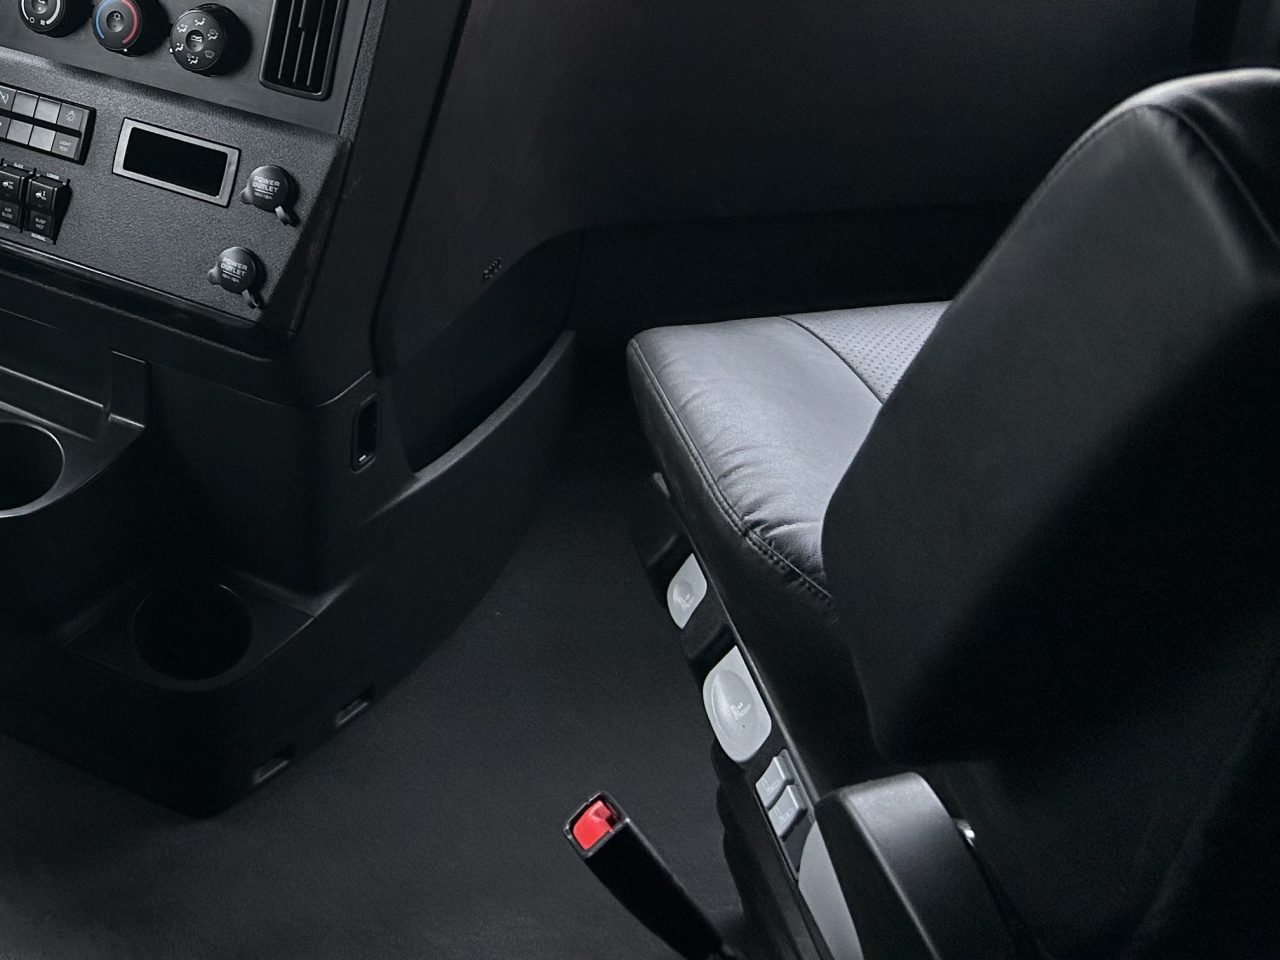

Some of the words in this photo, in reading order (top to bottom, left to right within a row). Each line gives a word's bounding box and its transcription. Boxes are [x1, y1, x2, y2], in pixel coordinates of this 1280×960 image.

[252, 181, 279, 193] OUTLET
[253, 175, 280, 187] POWER
[220, 262, 247, 277] OUTLET
[222, 256, 248, 271] POWER
